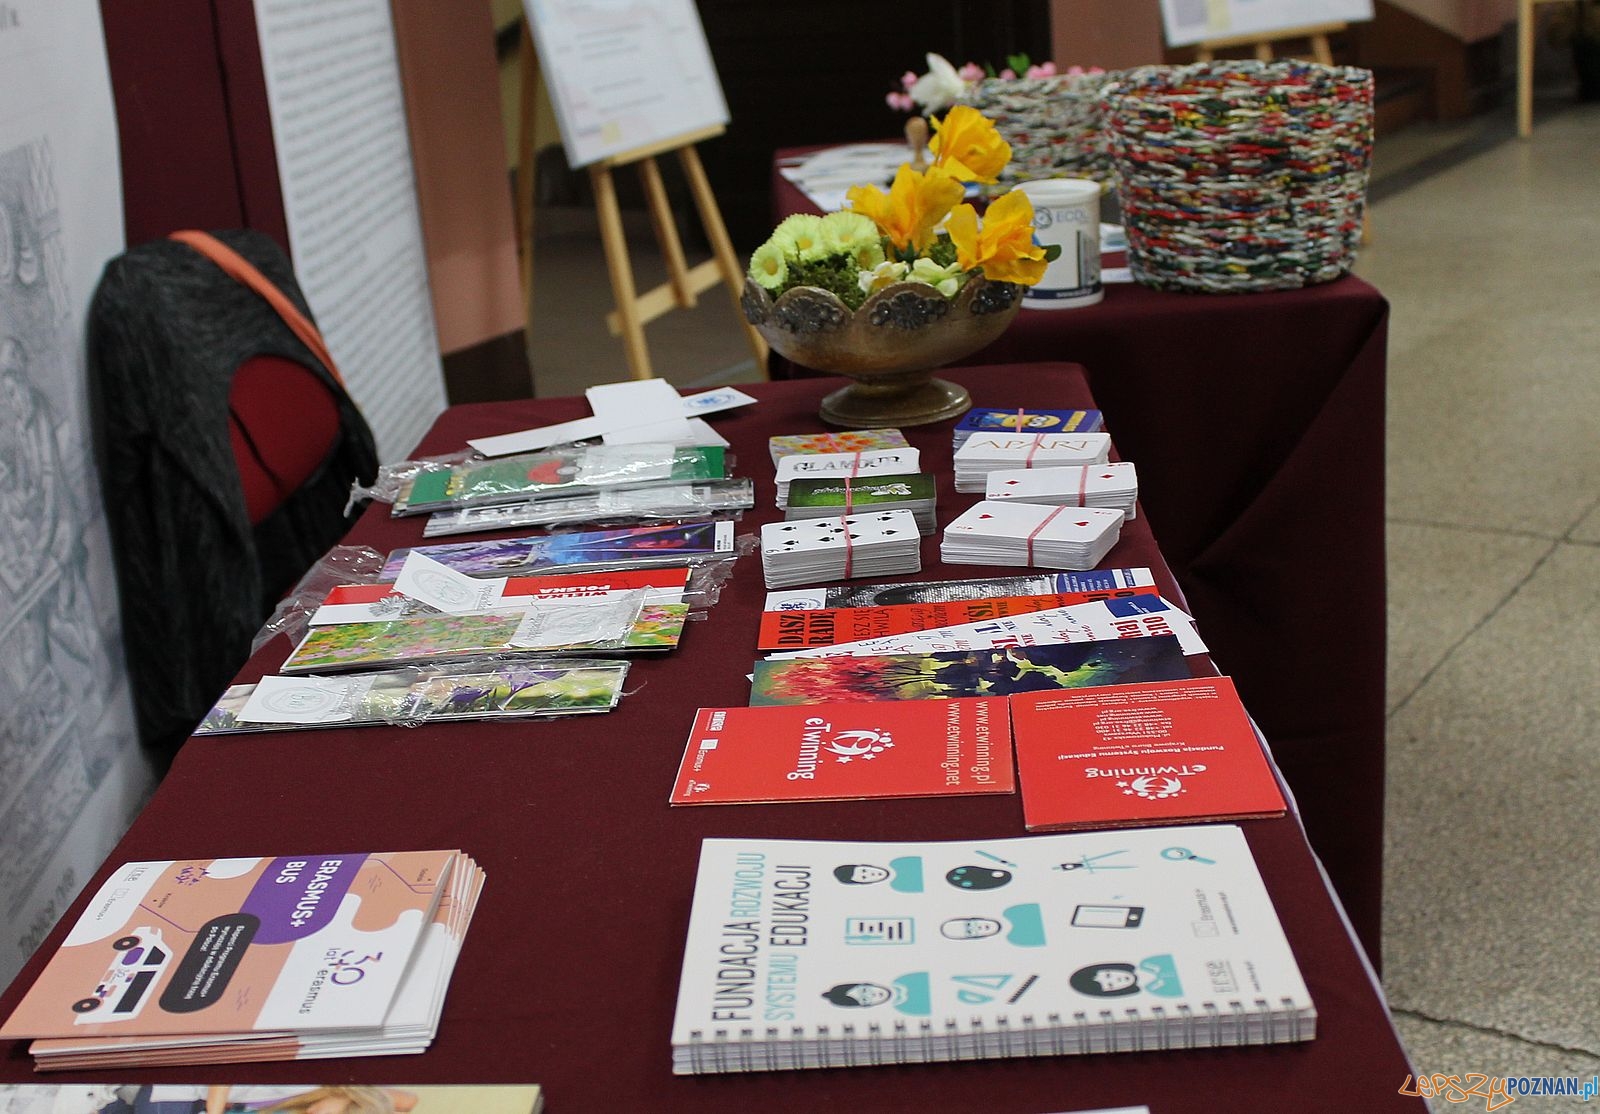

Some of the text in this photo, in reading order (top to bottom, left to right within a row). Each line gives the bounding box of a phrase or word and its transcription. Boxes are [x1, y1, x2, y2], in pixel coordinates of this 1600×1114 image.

[537, 592, 608, 600] WIELKA
[539, 584, 611, 594] POLSKA
[777, 613, 806, 645] DASZ
[873, 608, 894, 638] HWILĄ
[786, 716, 833, 782] eTwinning
[940, 702, 961, 787] www.etwinning.net
[970, 701, 996, 785] www.etwinning.pl
[1057, 752, 1097, 760] Edukacji
[1098, 749, 1139, 758] Systemu
[1084, 763, 1208, 779] eTwinning
[275, 860, 307, 884] BUS
[290, 859, 343, 928] ERASMUS+
[712, 852, 767, 1022] FUNDACJA ROZWOJU
[763, 864, 812, 1022] SYSTEMU EDUKACJI
[299, 968, 329, 1015] erasmus
